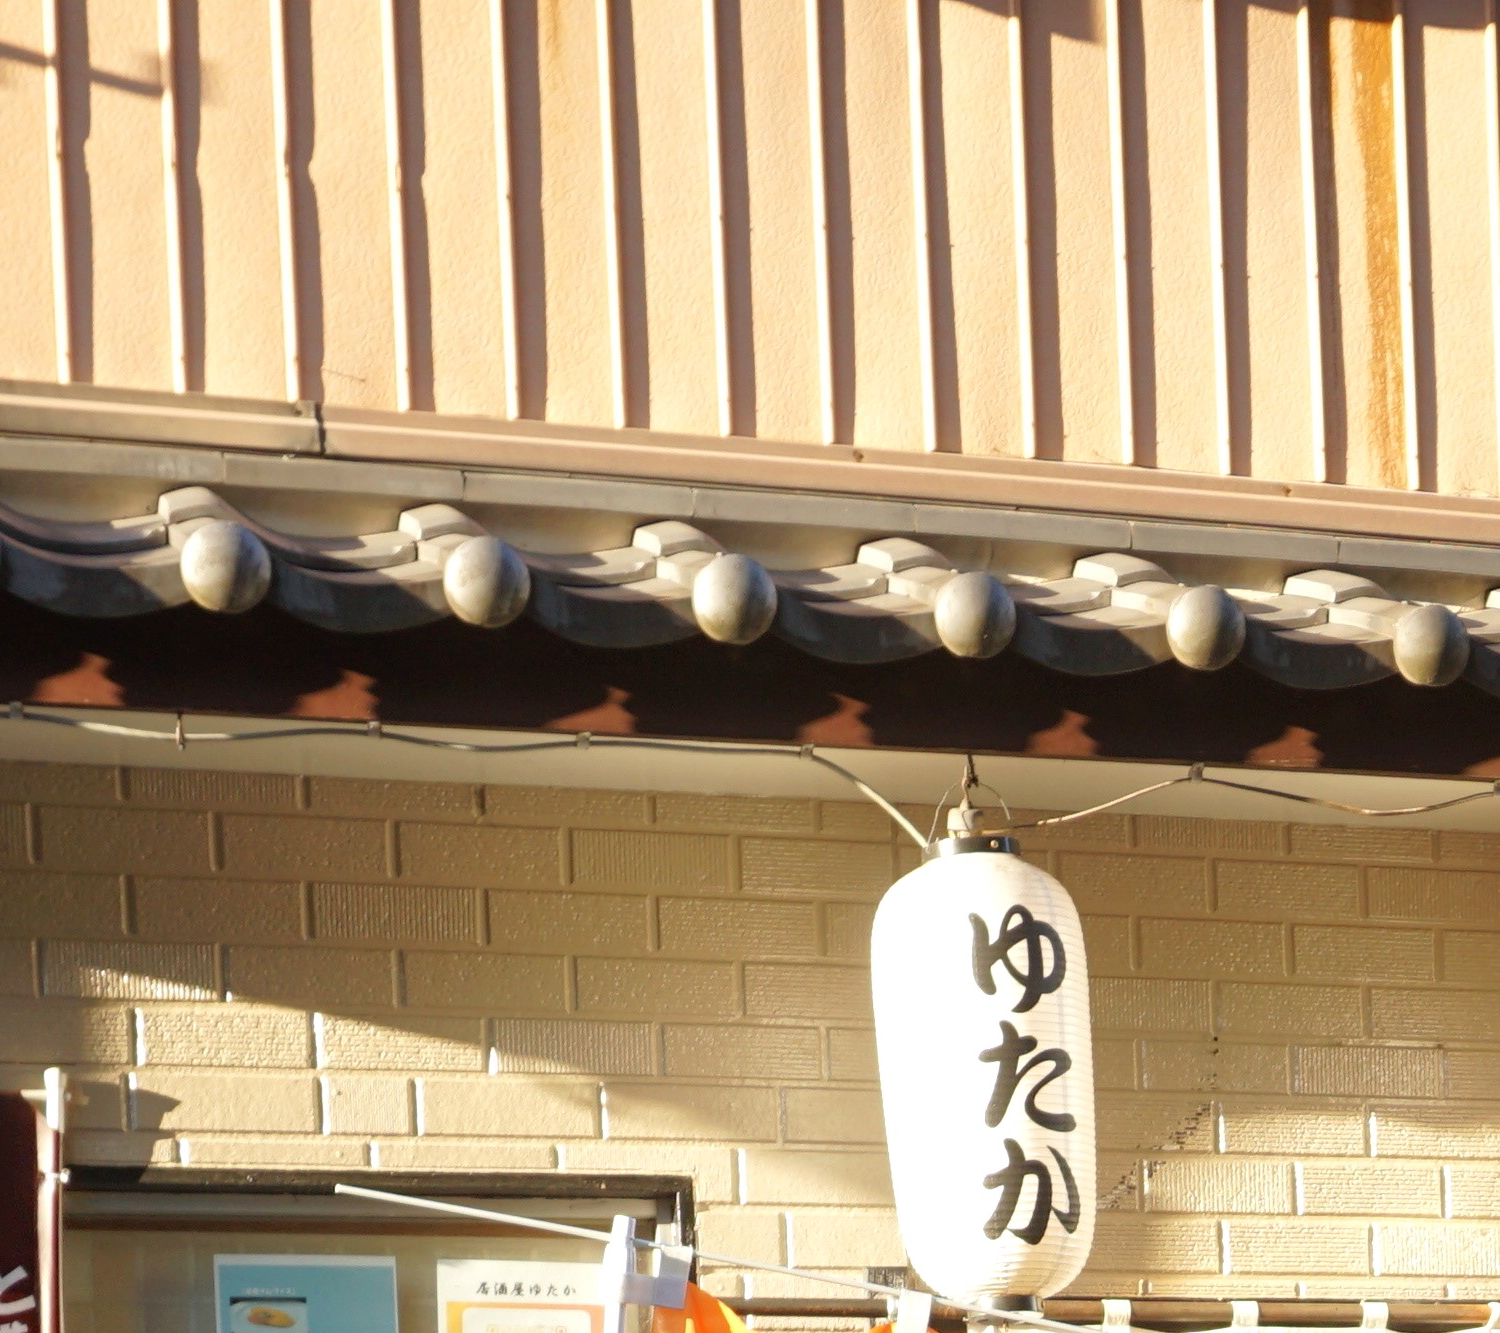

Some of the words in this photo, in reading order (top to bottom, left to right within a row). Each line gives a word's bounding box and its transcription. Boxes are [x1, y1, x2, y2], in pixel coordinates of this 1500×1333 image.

[967, 903, 1082, 1247] ゆたか
[476, 1281, 577, 1297] 居酒屋ゆたか
